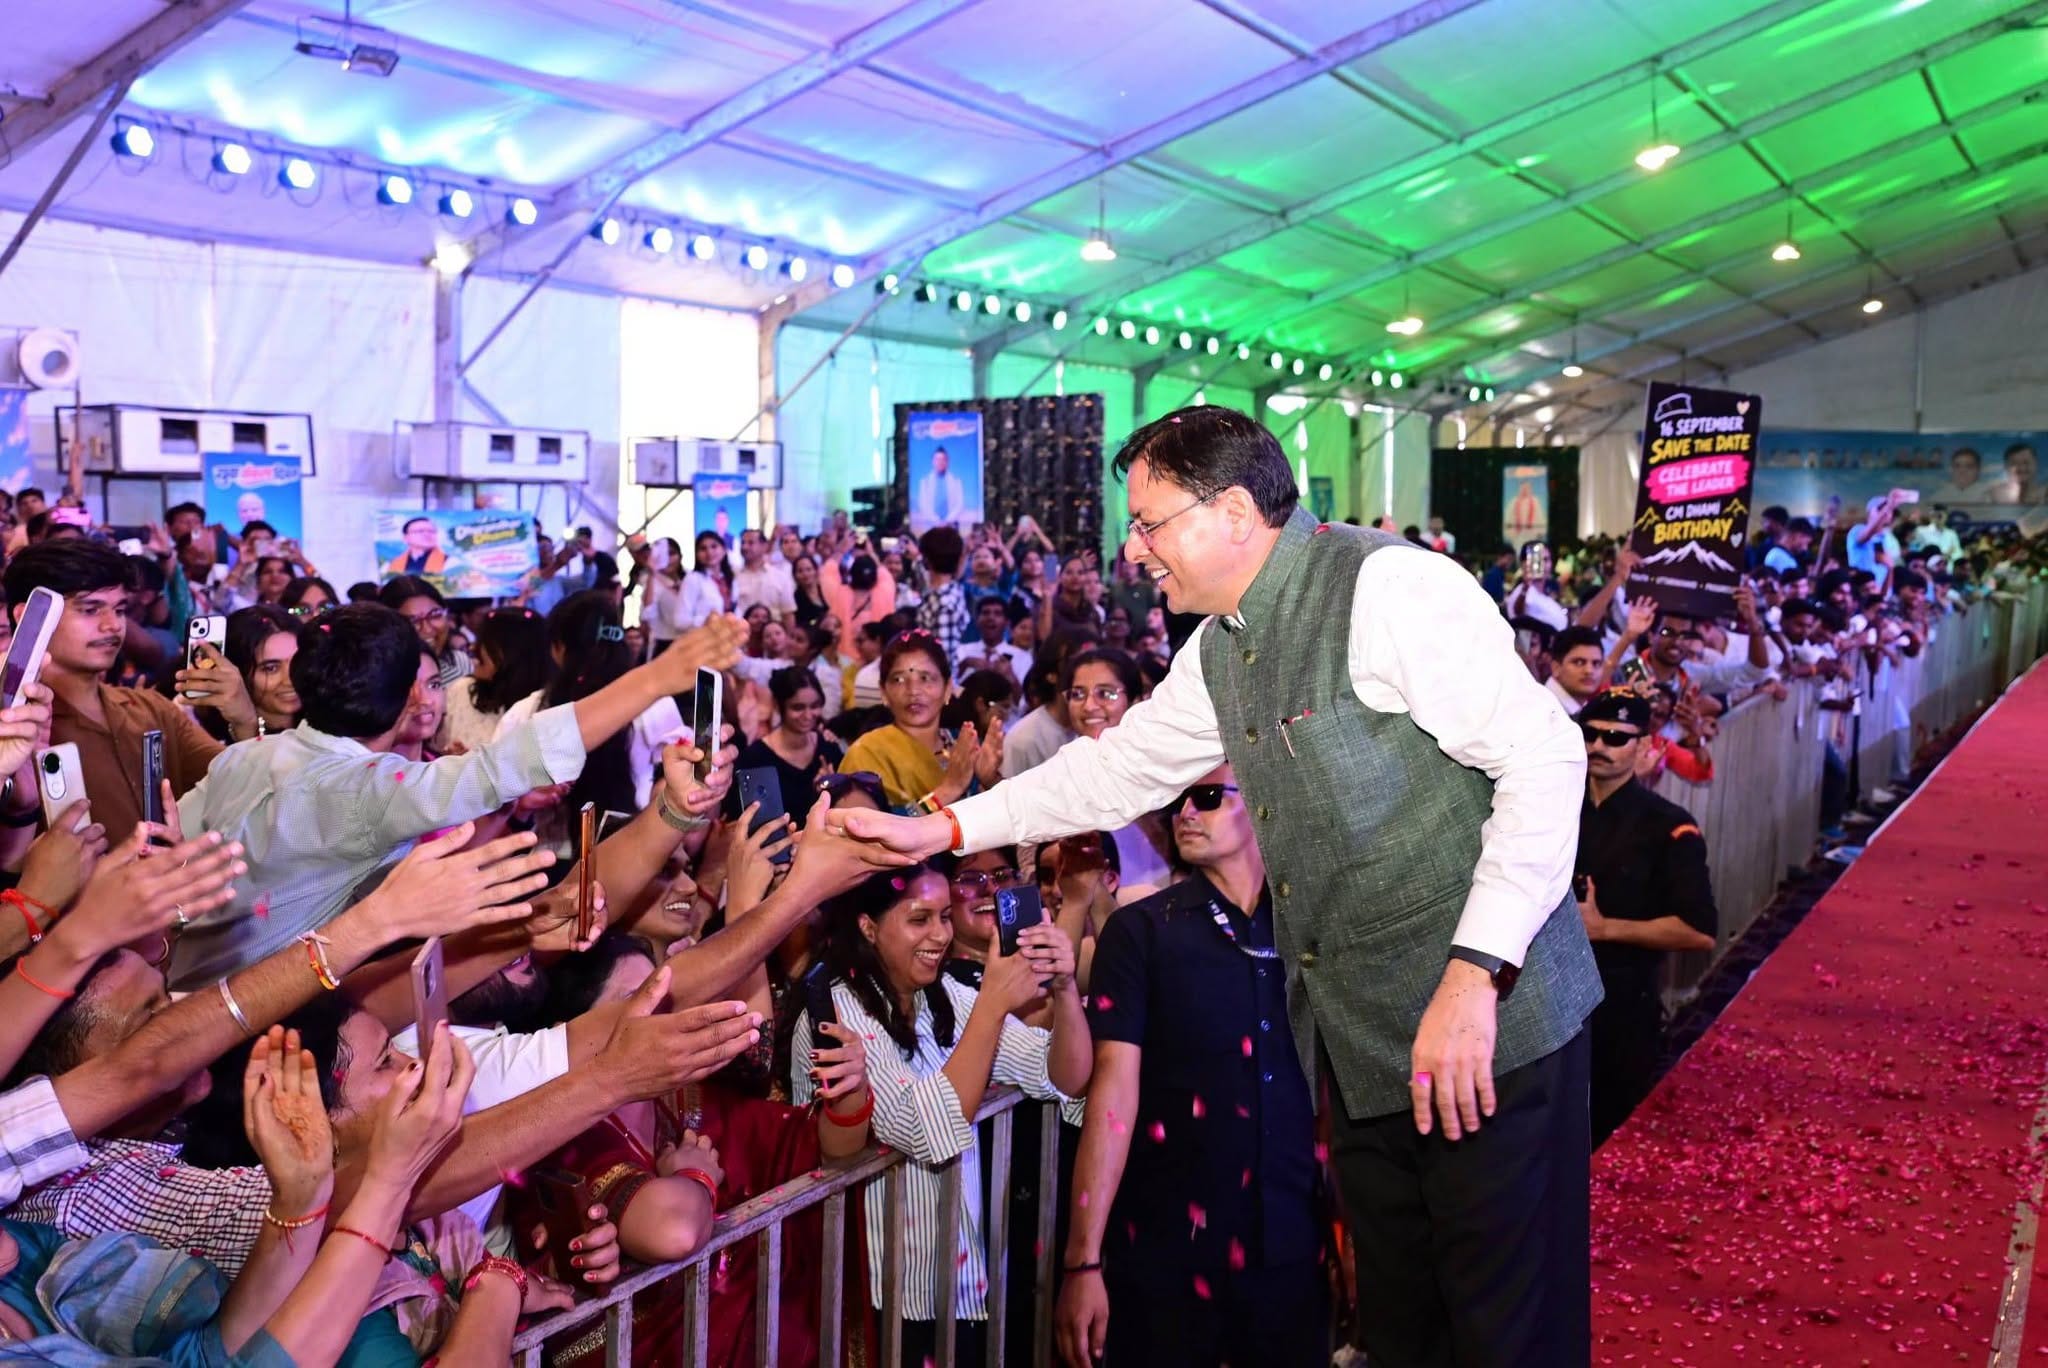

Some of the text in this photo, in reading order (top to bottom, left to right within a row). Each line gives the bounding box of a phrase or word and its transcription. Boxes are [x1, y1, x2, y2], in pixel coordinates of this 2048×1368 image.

[1660, 415, 1744, 437] 16 SEPTEMBER
[1648, 433, 1751, 465] SAVE THE DATE
[1658, 460, 1733, 484] CELEBRATE
[1665, 476, 1735, 497] THE LEADER
[1665, 501, 1720, 521] CM DHAMI
[1653, 518, 1733, 545] BIRTHDAY
